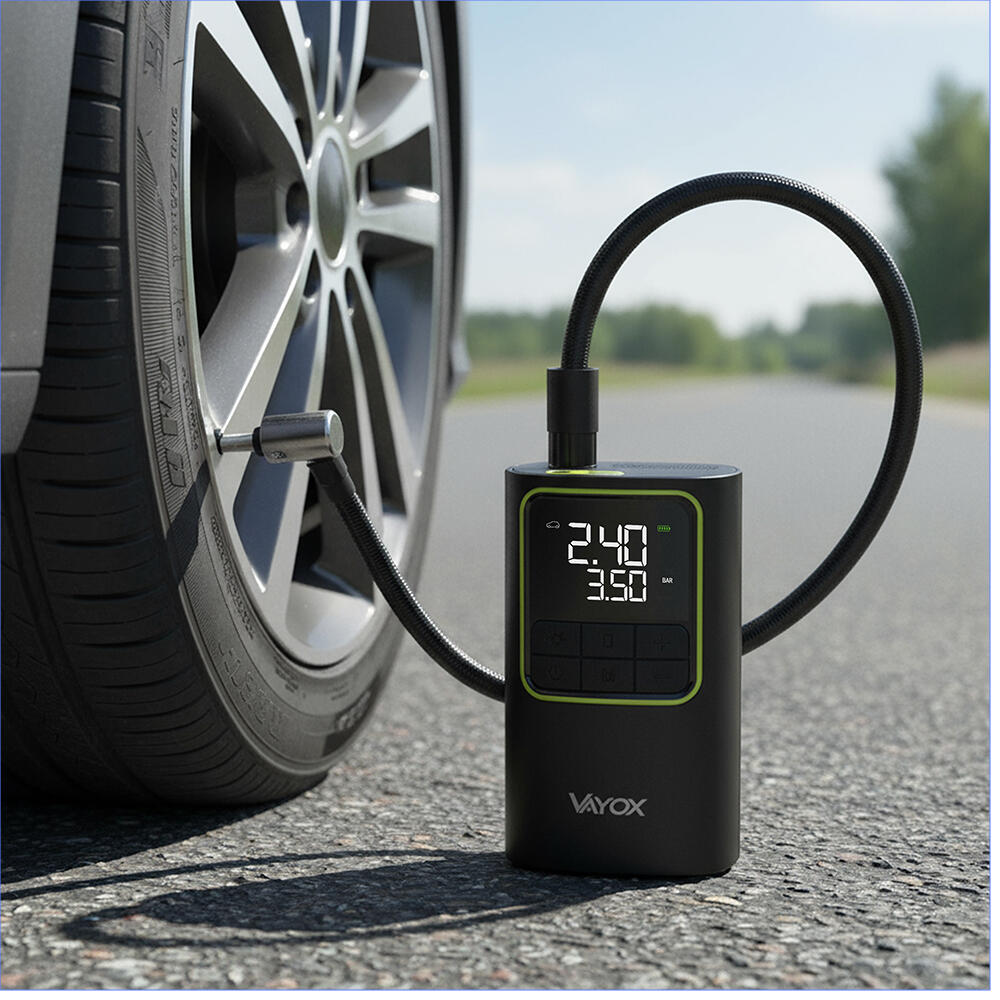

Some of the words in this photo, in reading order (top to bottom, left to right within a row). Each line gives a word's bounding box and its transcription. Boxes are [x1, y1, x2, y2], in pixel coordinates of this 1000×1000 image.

[567, 521, 648, 567] 2.40
[586, 568, 647, 603] 3.50
[661, 576, 674, 584] BAR
[568, 792, 648, 817] VAYOX
